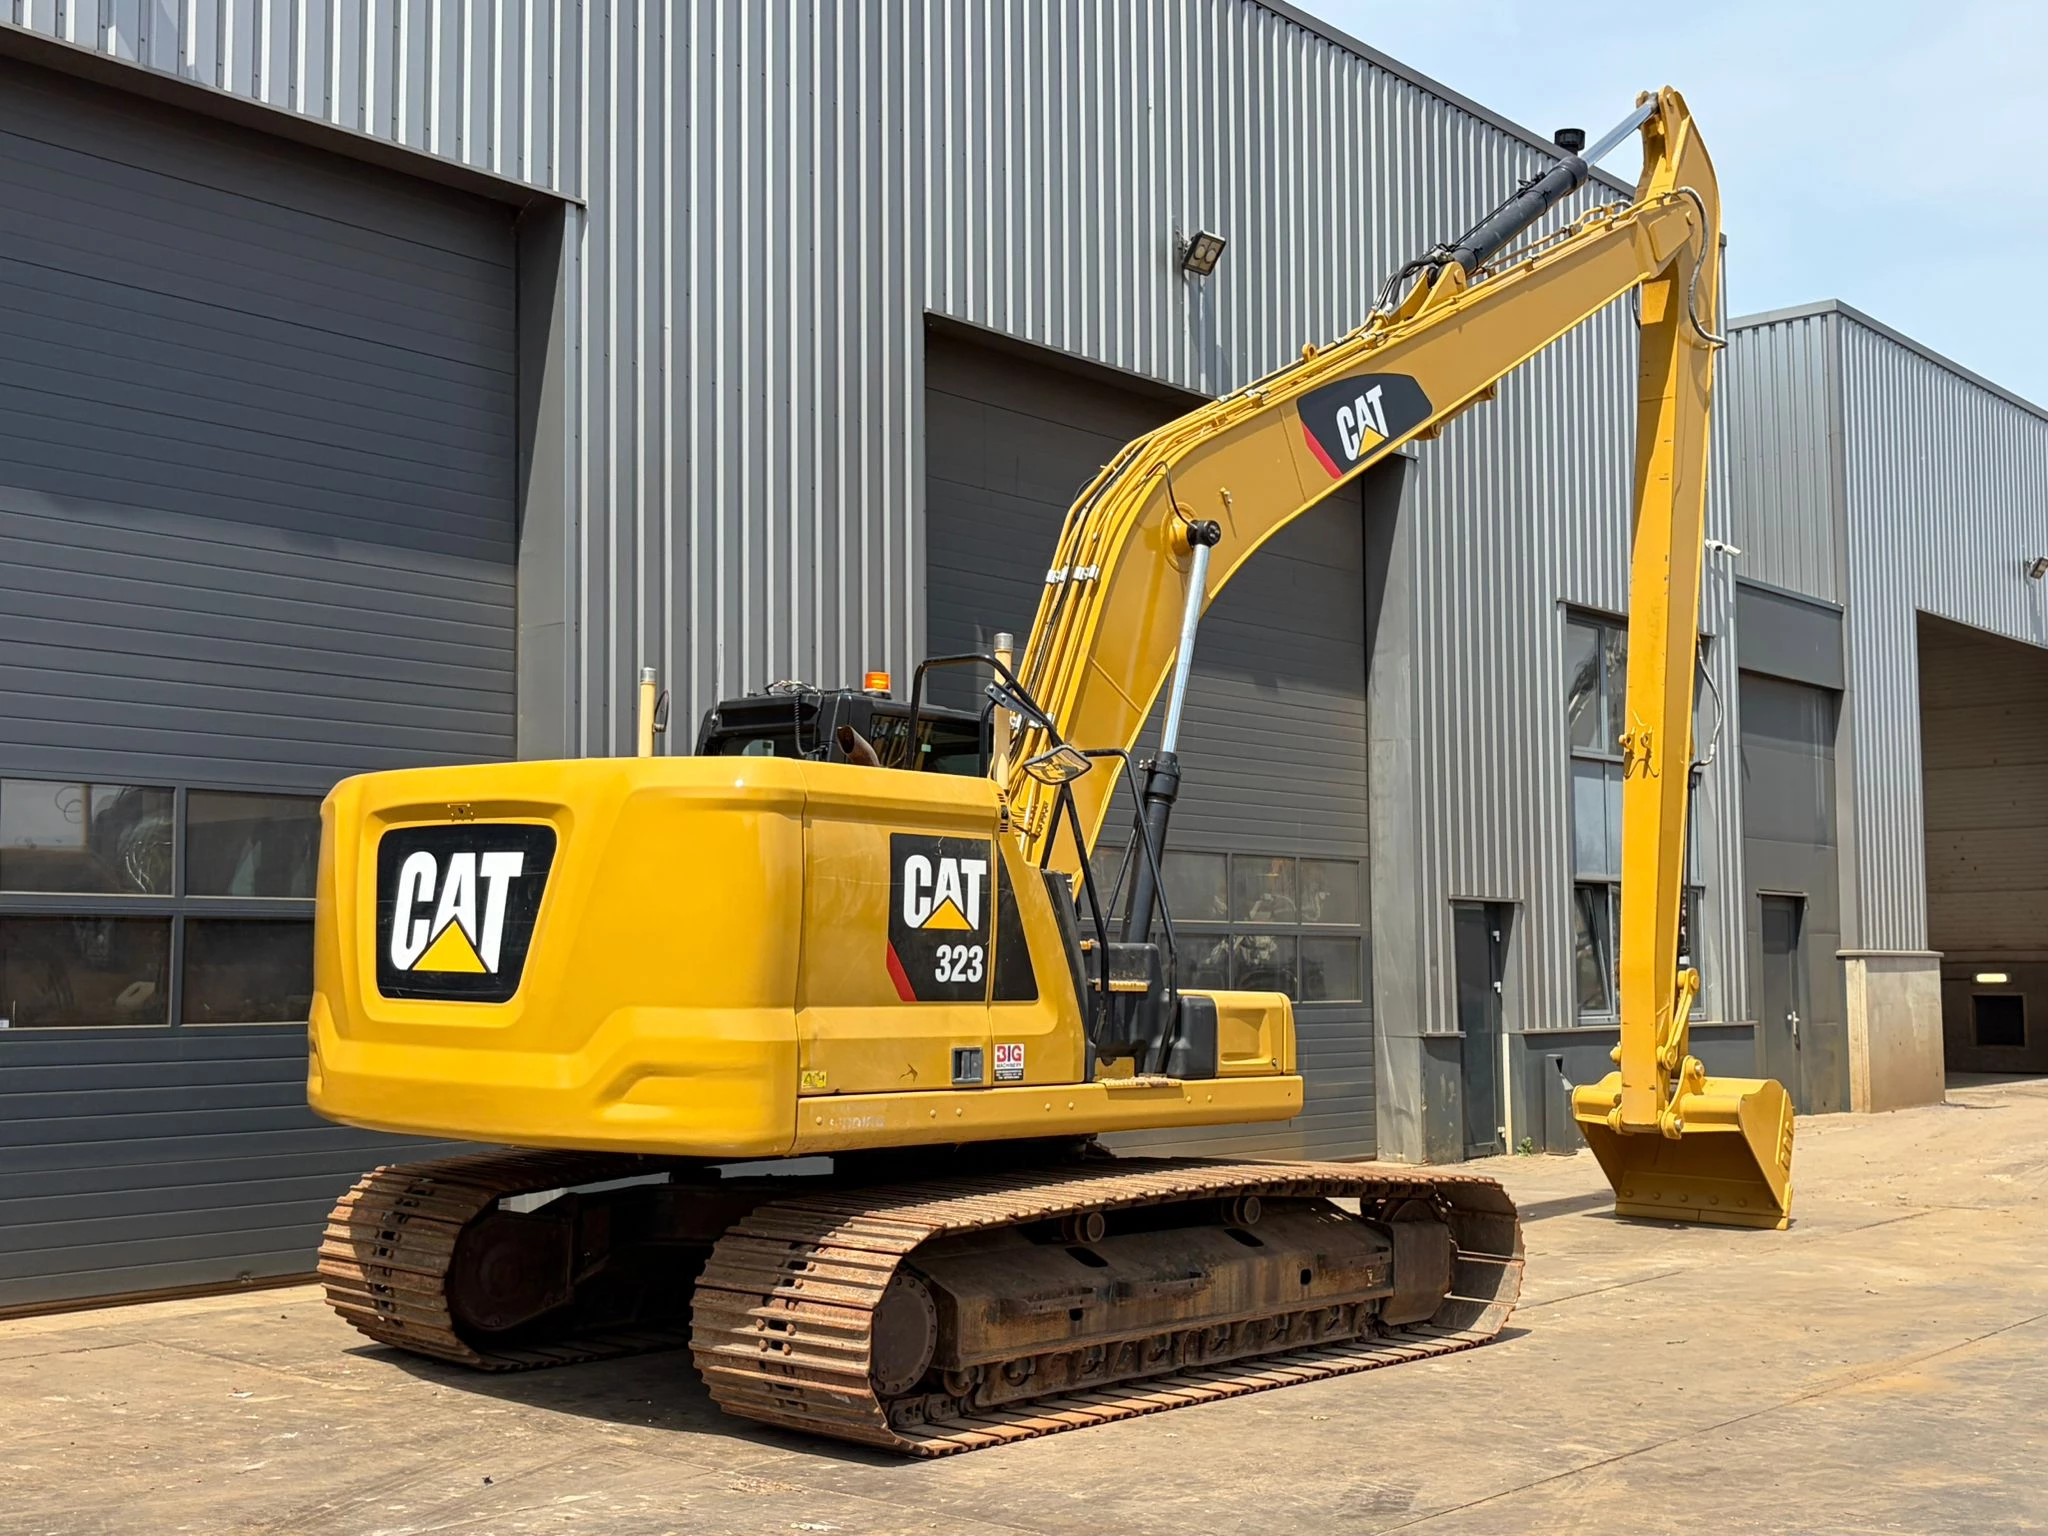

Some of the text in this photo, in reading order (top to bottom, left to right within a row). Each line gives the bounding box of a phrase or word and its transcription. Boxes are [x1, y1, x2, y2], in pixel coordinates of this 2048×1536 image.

[1336, 384, 1389, 461] CAT
[391, 851, 524, 973] CAT
[904, 855, 987, 930] CAT
[935, 945, 983, 982] 323
[997, 1045, 1022, 1062] BIG
